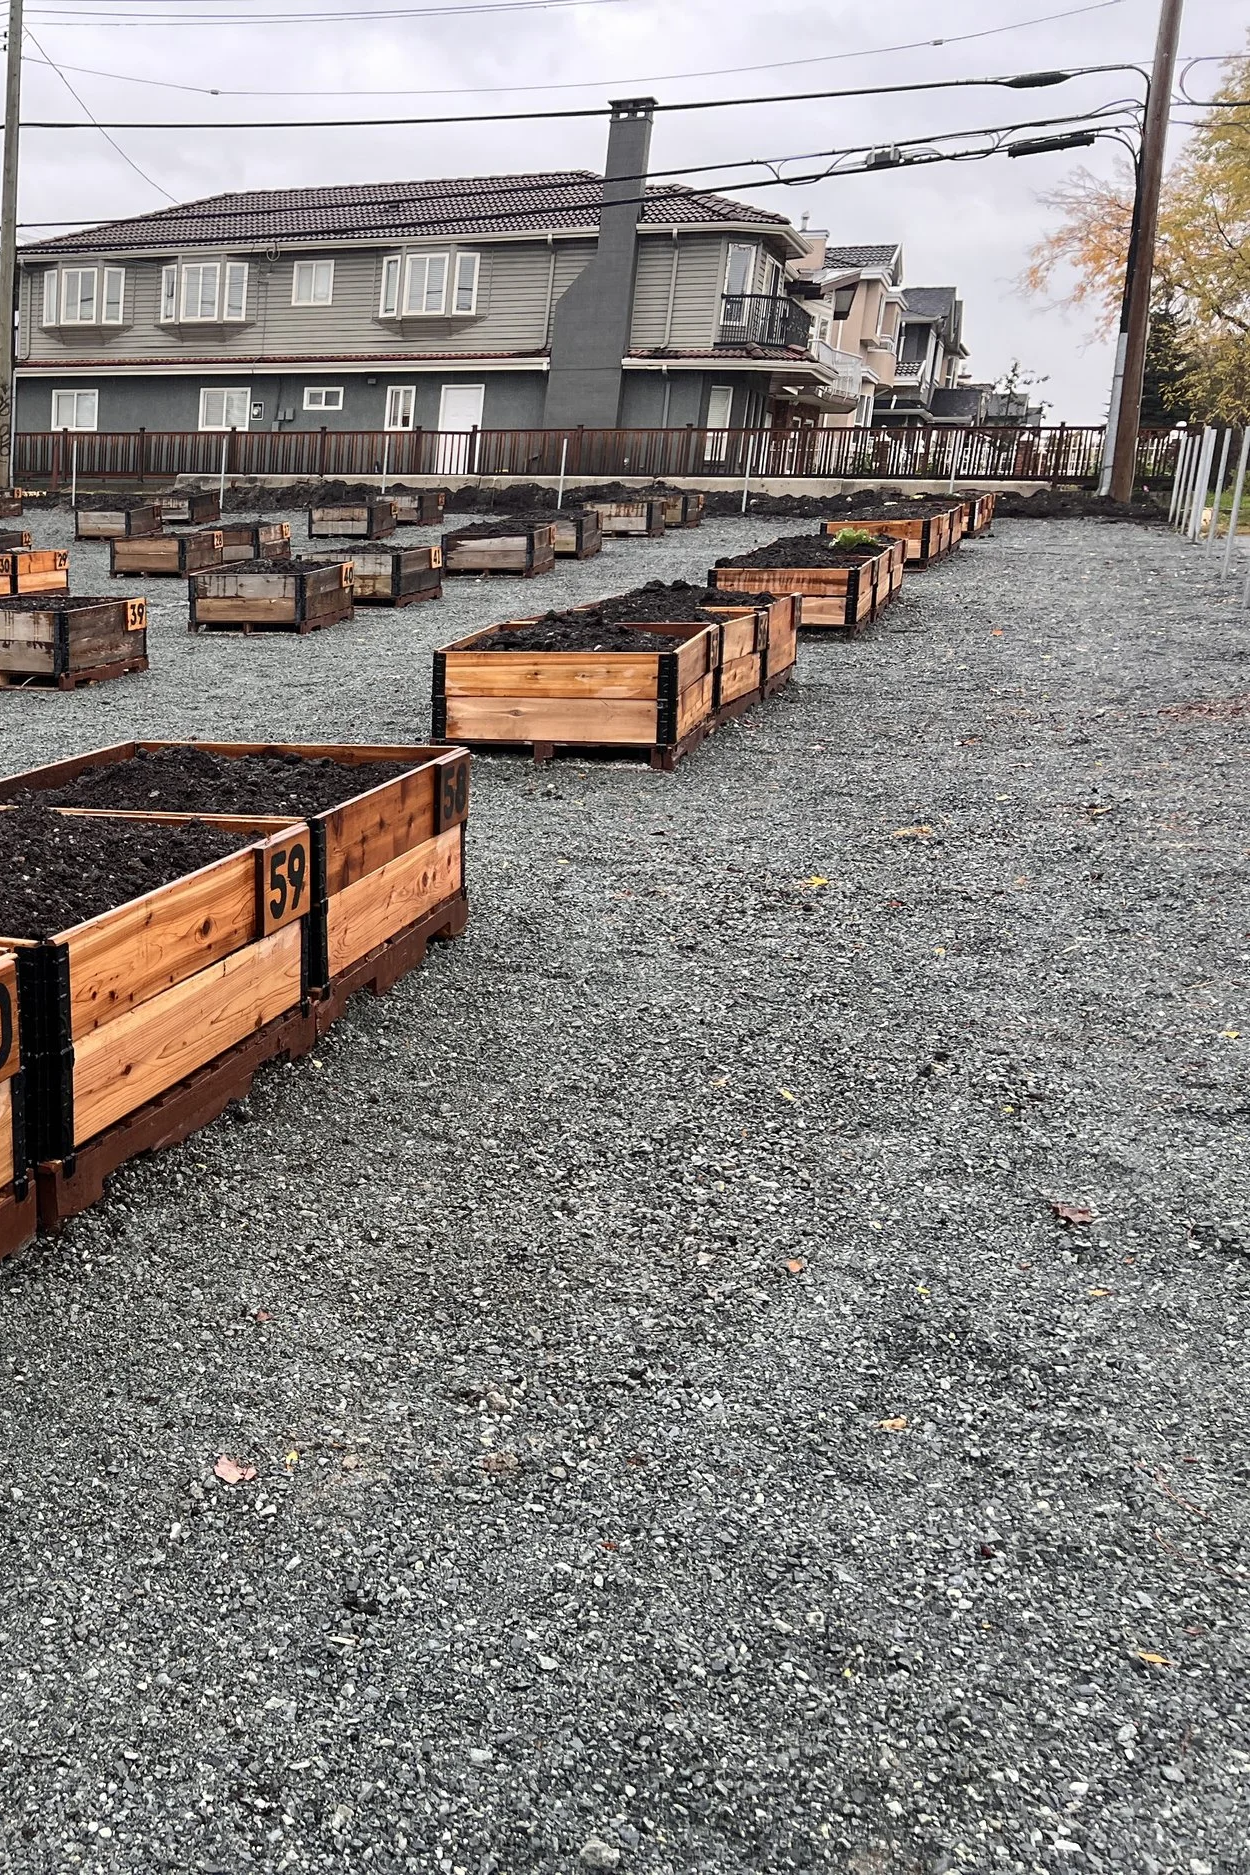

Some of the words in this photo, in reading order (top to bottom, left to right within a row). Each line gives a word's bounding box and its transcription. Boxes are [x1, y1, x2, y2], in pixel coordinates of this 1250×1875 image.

[0, 558, 10, 573] 30
[57, 552, 68, 567] 29
[433, 549, 441, 565] 41
[344, 566, 354, 584] 40
[130, 603, 144, 625] 39
[443, 763, 467, 820] 58
[270, 843, 306, 919] 59
